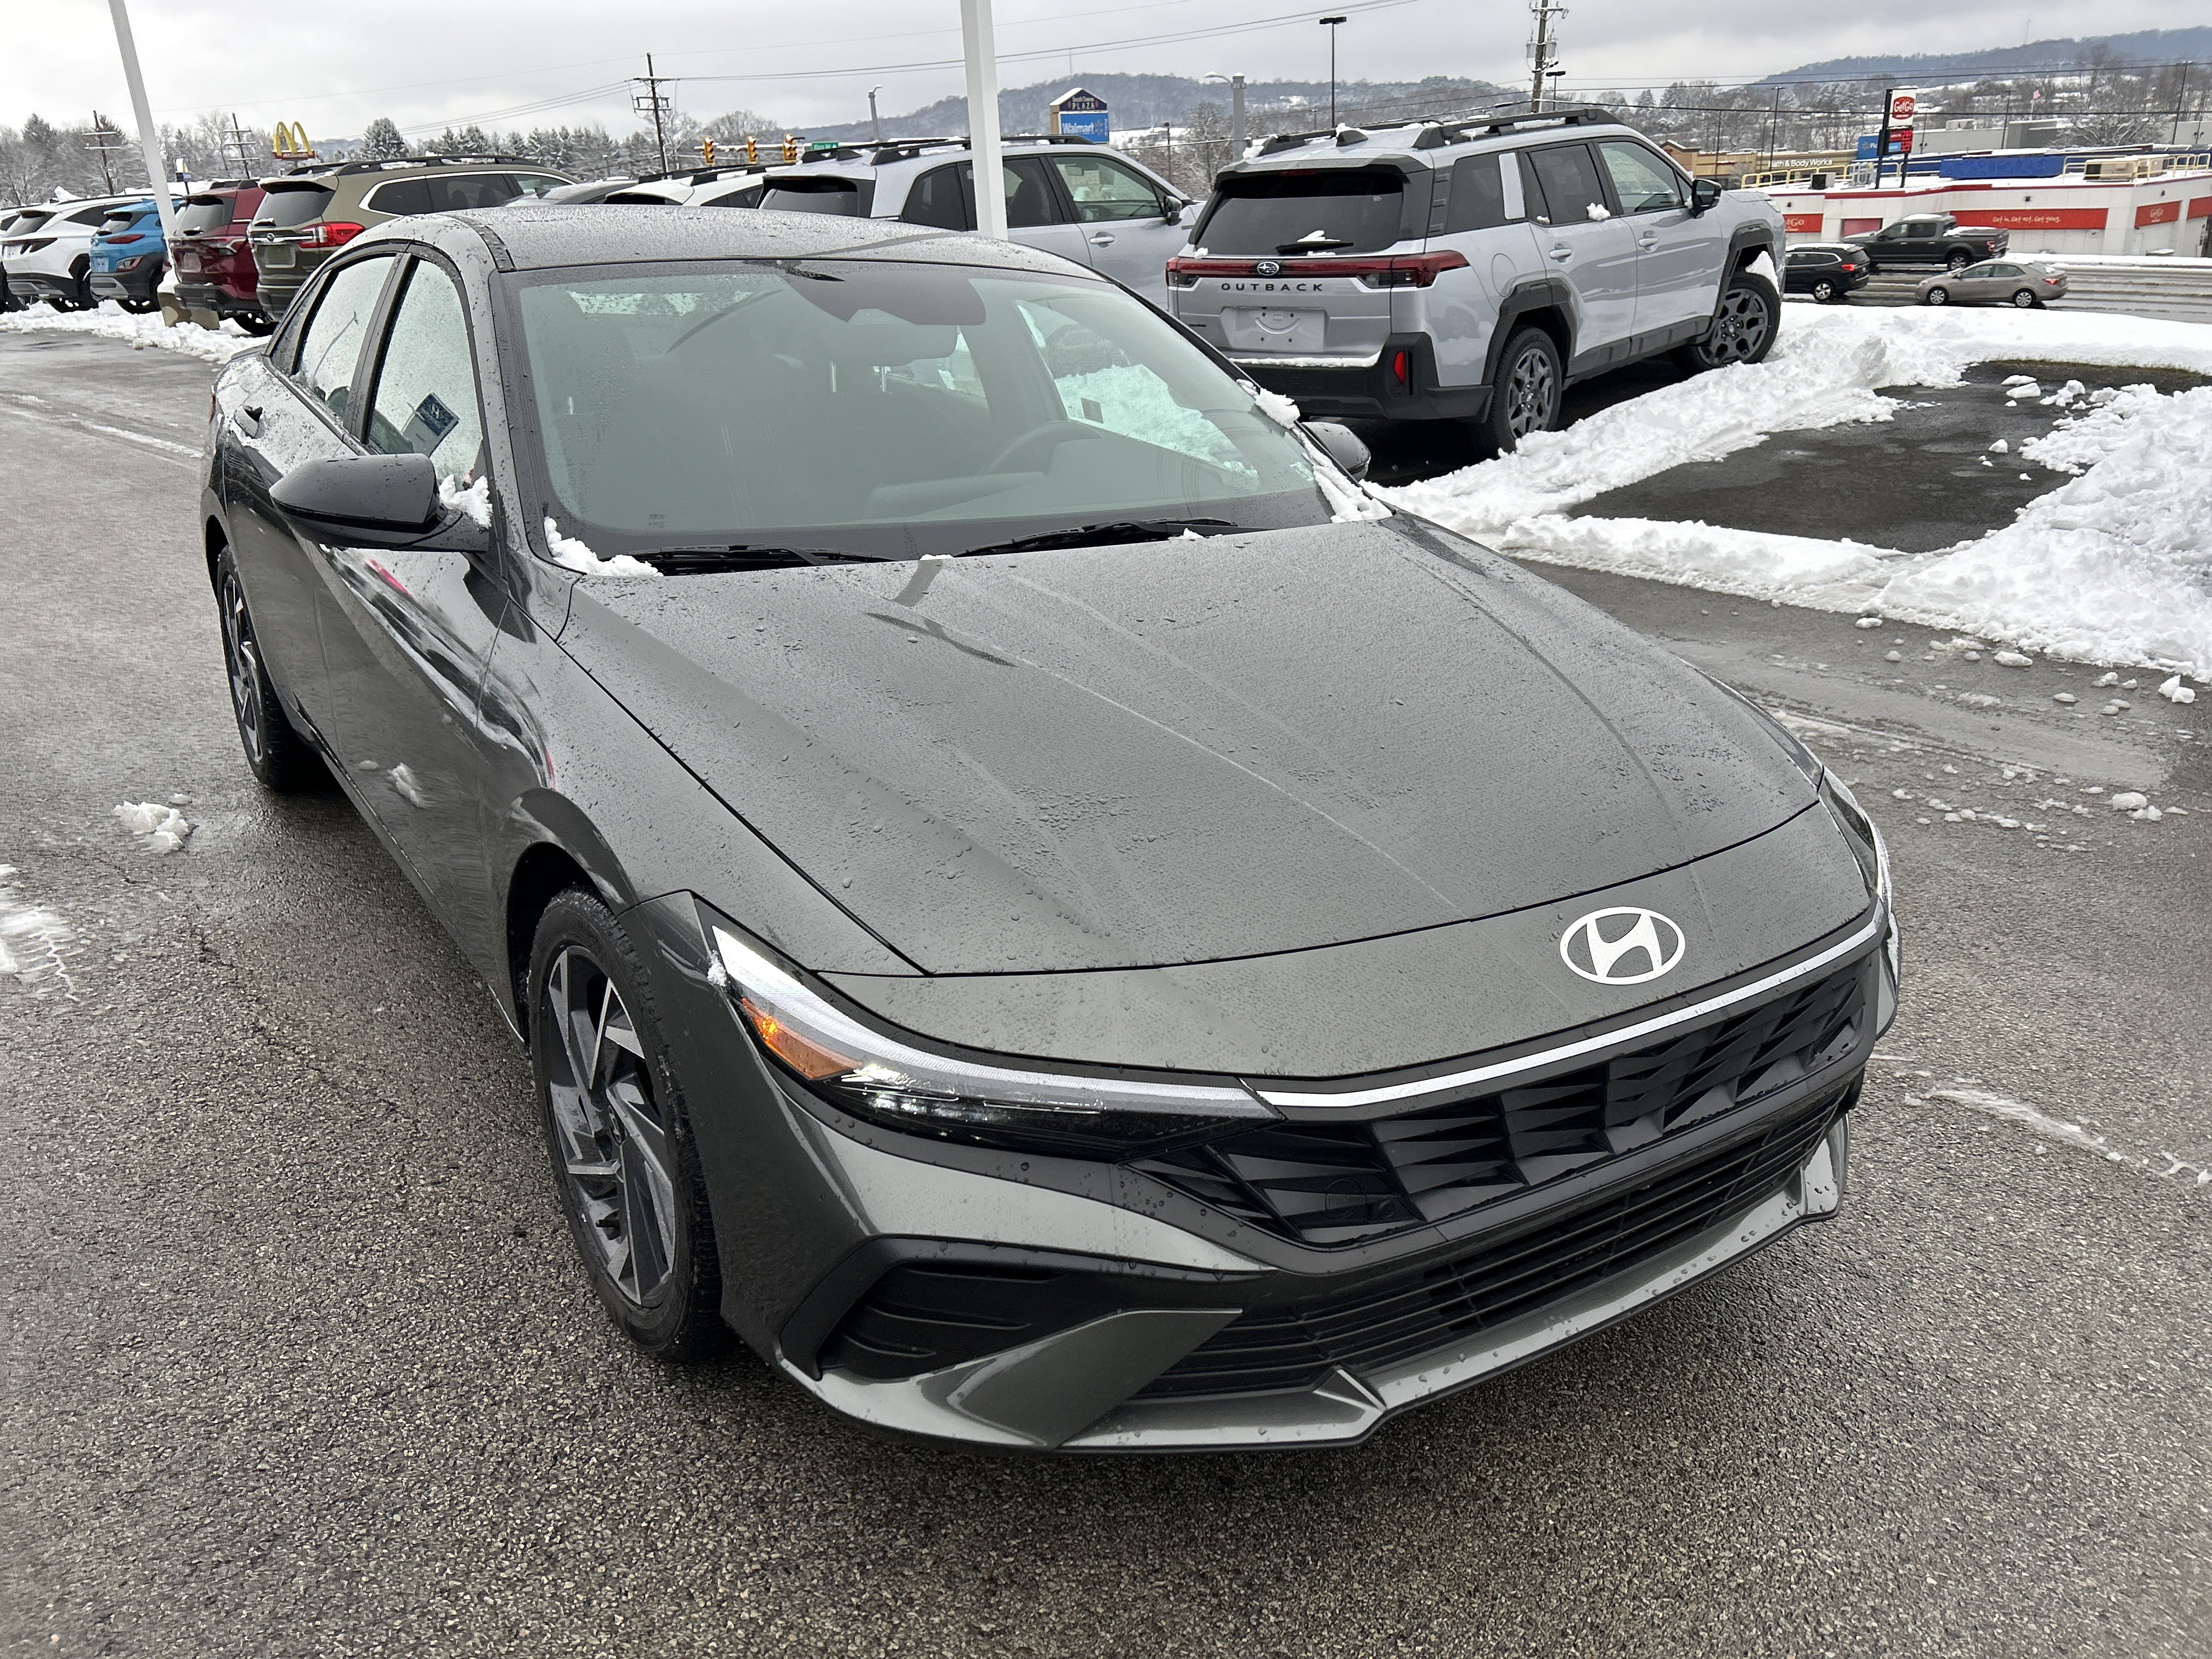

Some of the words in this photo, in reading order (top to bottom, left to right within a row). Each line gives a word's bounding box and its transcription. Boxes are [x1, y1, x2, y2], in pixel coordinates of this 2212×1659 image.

[1894, 100, 1914, 112] GetGo
[1062, 122, 1094, 134] Walmart
[1221, 283, 1324, 291] OUTBACK
